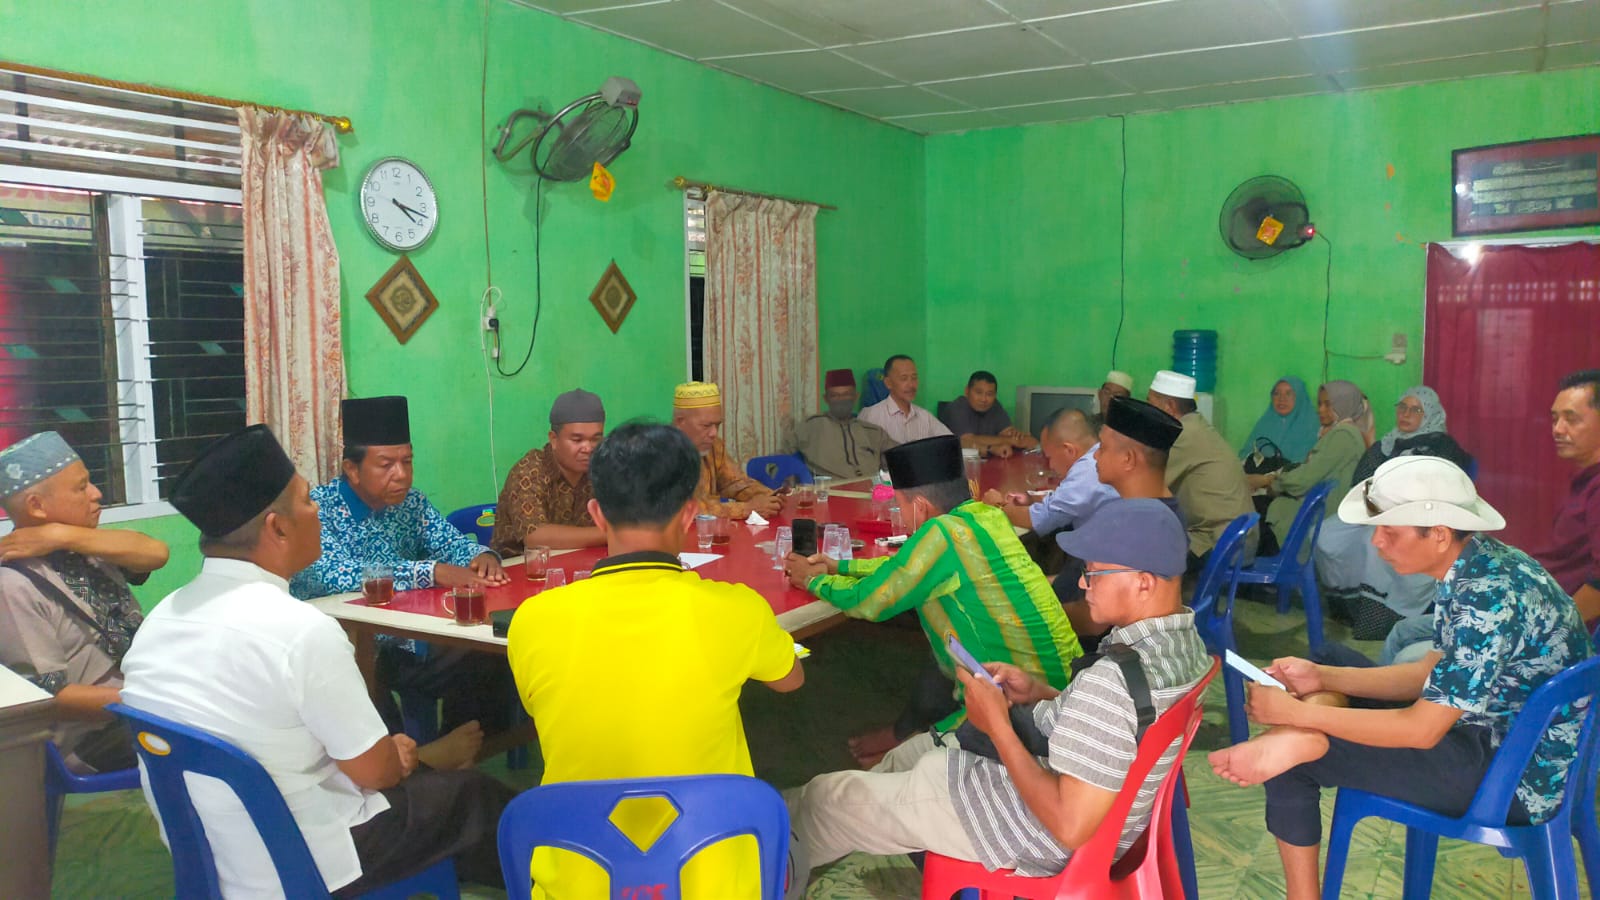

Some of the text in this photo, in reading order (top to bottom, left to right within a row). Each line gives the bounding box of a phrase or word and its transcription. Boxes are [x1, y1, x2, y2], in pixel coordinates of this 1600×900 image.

[392, 168, 400, 178] 12
[370, 181, 380, 192] 10
[416, 186, 422, 197] 2
[367, 196, 376, 207] 9
[420, 202, 426, 212] 3
[372, 213, 379, 224] 8
[416, 218, 424, 226] 4
[382, 226, 389, 236] 7
[408, 229, 415, 239] 5
[395, 232, 403, 242] 6
